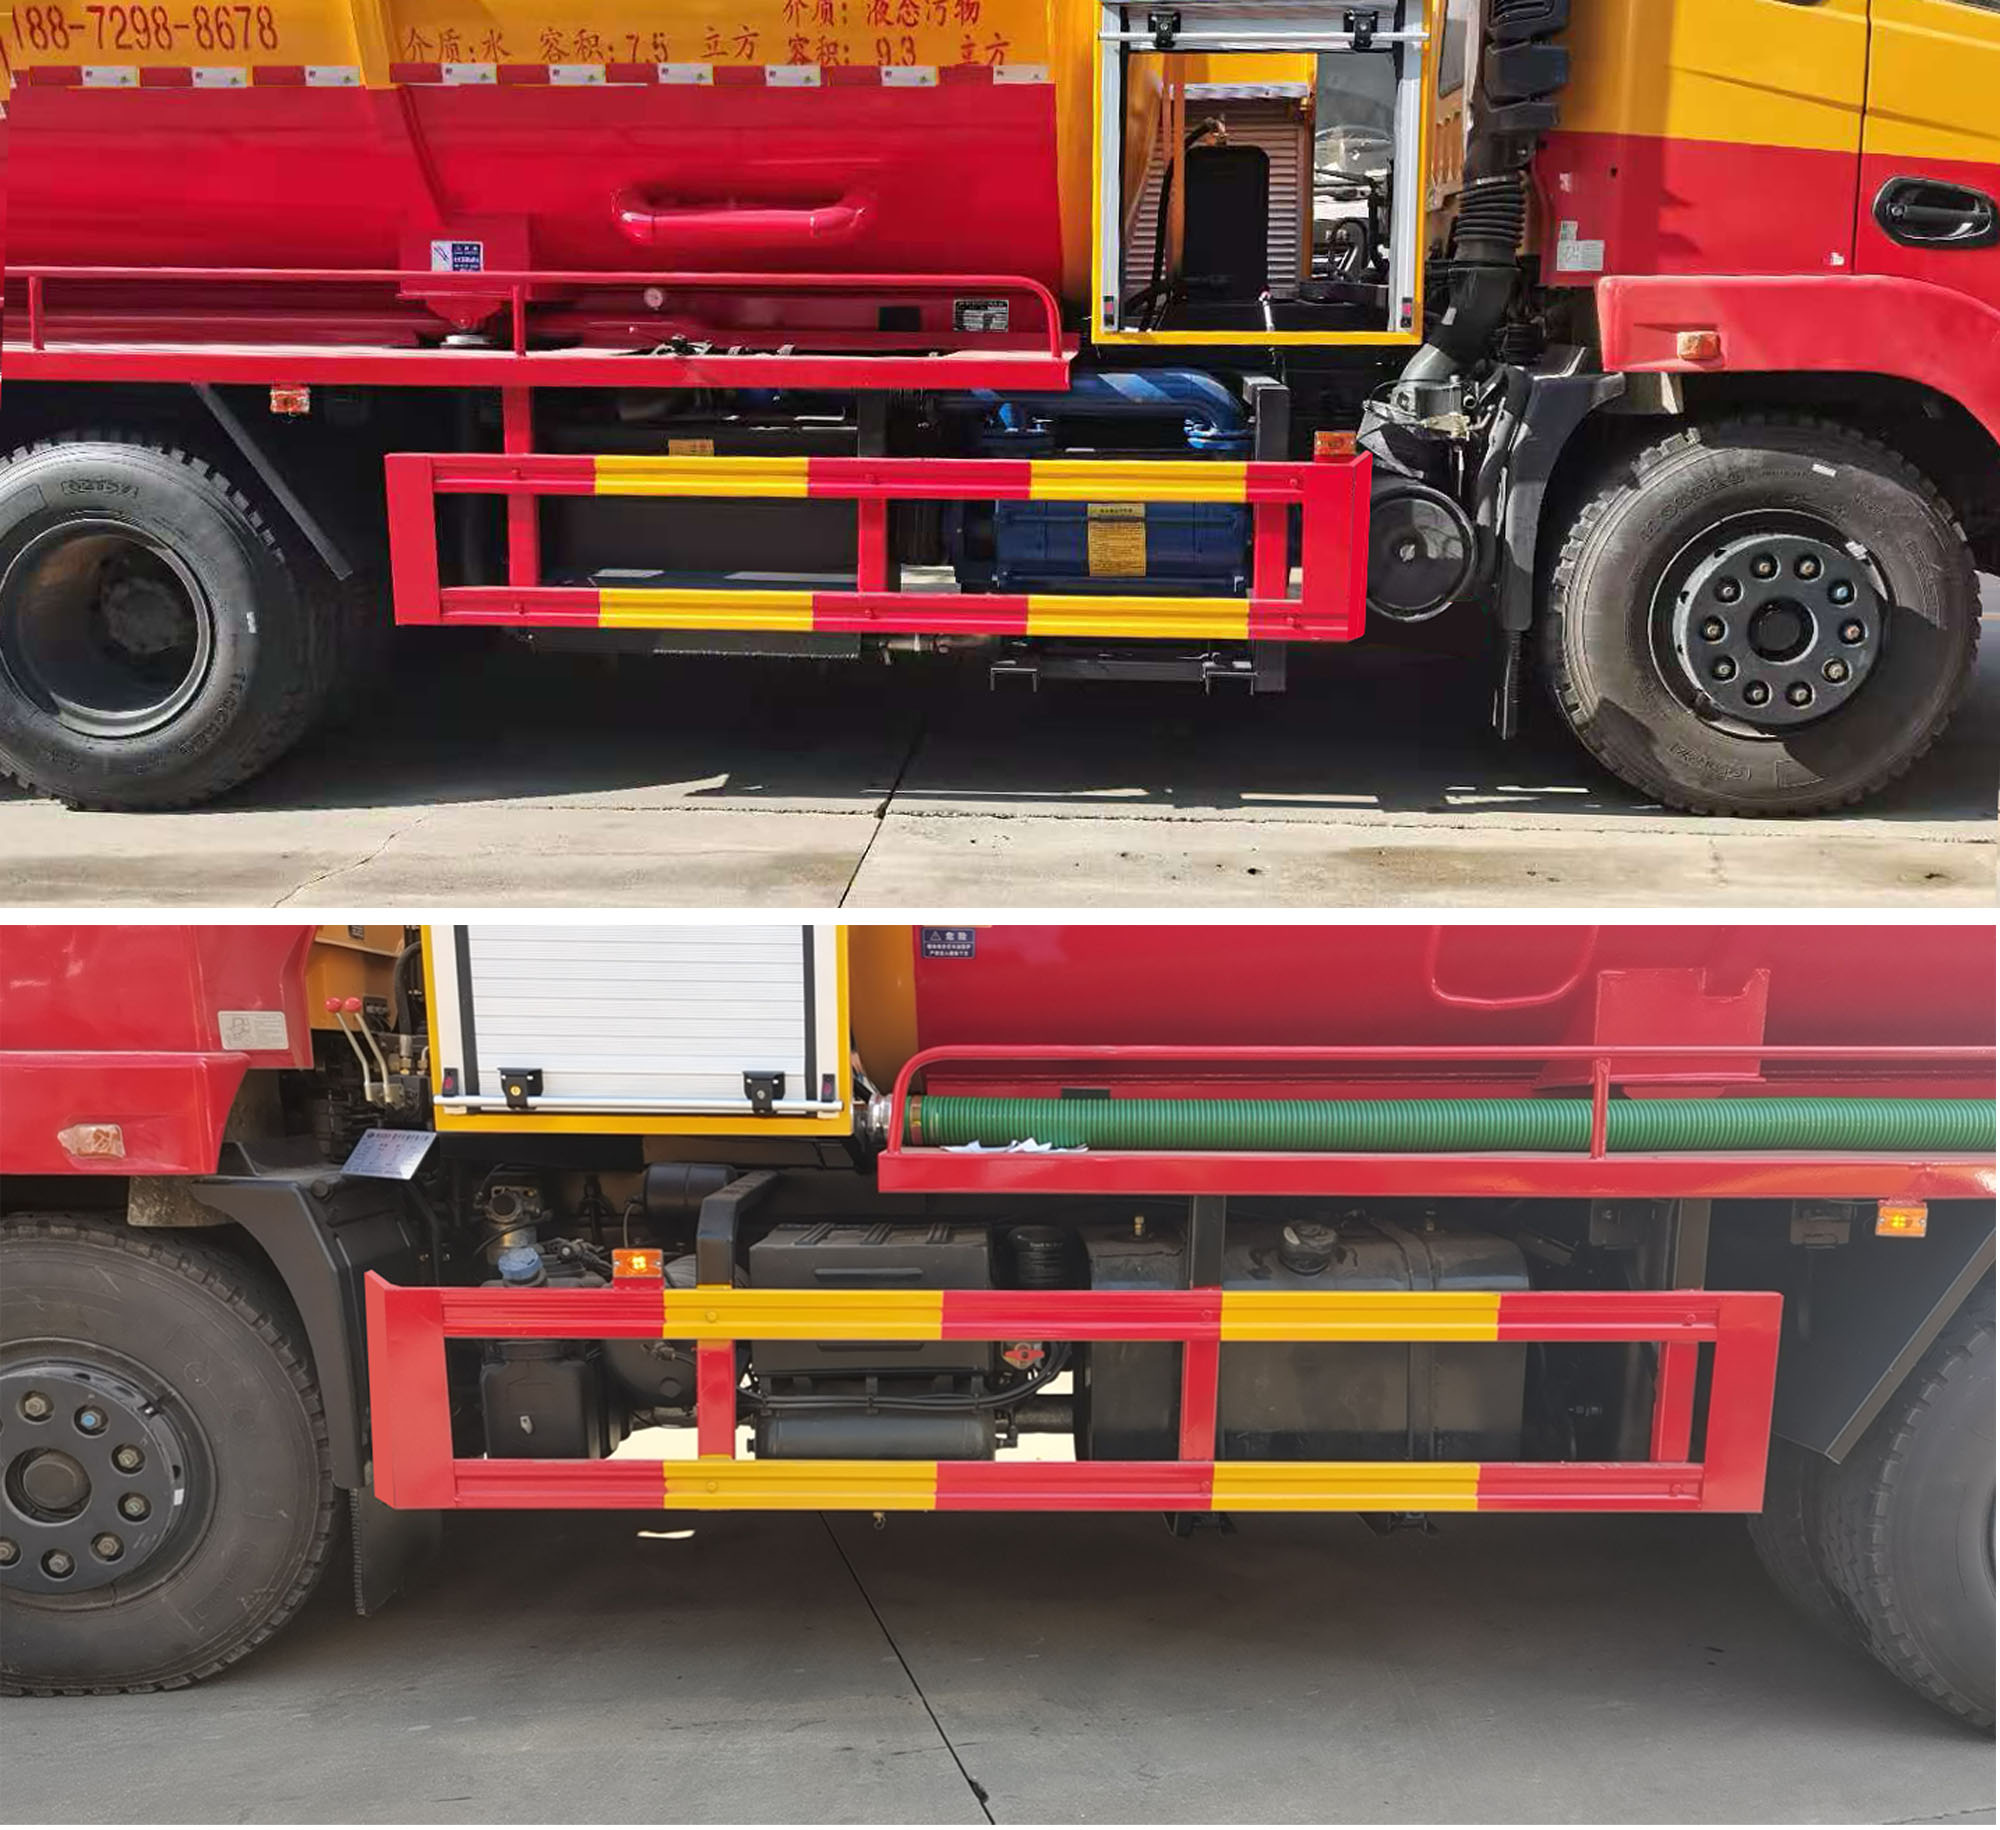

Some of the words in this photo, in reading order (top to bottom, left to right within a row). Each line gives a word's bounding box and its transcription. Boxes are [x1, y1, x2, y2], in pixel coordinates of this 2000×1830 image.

[12, 5, 279, 50] 188-7298-8678
[700, 24, 760, 59] 立方
[959, 31, 1011, 66] 立方
